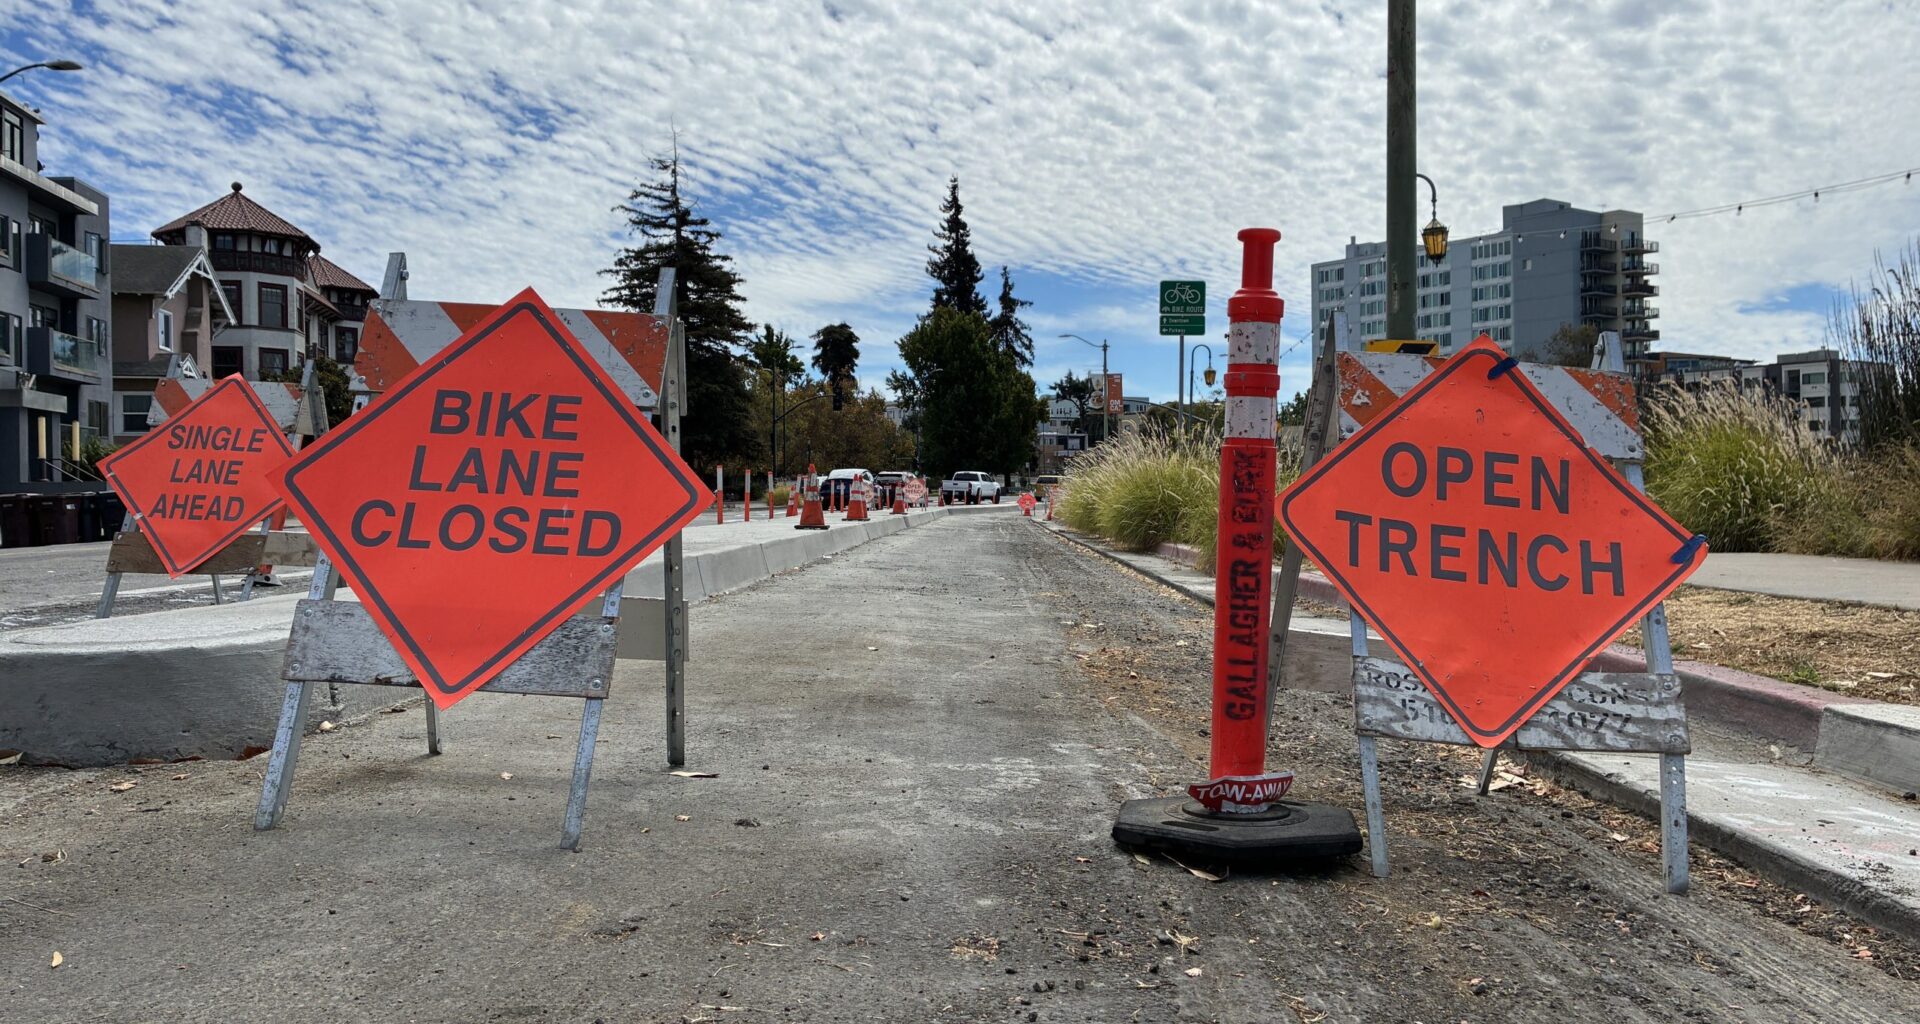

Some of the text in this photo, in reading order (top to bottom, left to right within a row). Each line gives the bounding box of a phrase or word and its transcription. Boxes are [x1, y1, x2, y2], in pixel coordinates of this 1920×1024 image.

[168, 424, 268, 453] SINGLE
[429, 389, 583, 441] BIKE
[170, 458, 244, 486] LANE
[408, 445, 584, 498] LANE
[1381, 441, 1570, 515] OPEN
[148, 493, 245, 522] AHEAD
[351, 499, 623, 557] CLOSED
[1335, 510, 1624, 597] TRENCH
[1225, 558, 1263, 721] GALLAGHER
[1197, 781, 1290, 801] TOW-AWAY
